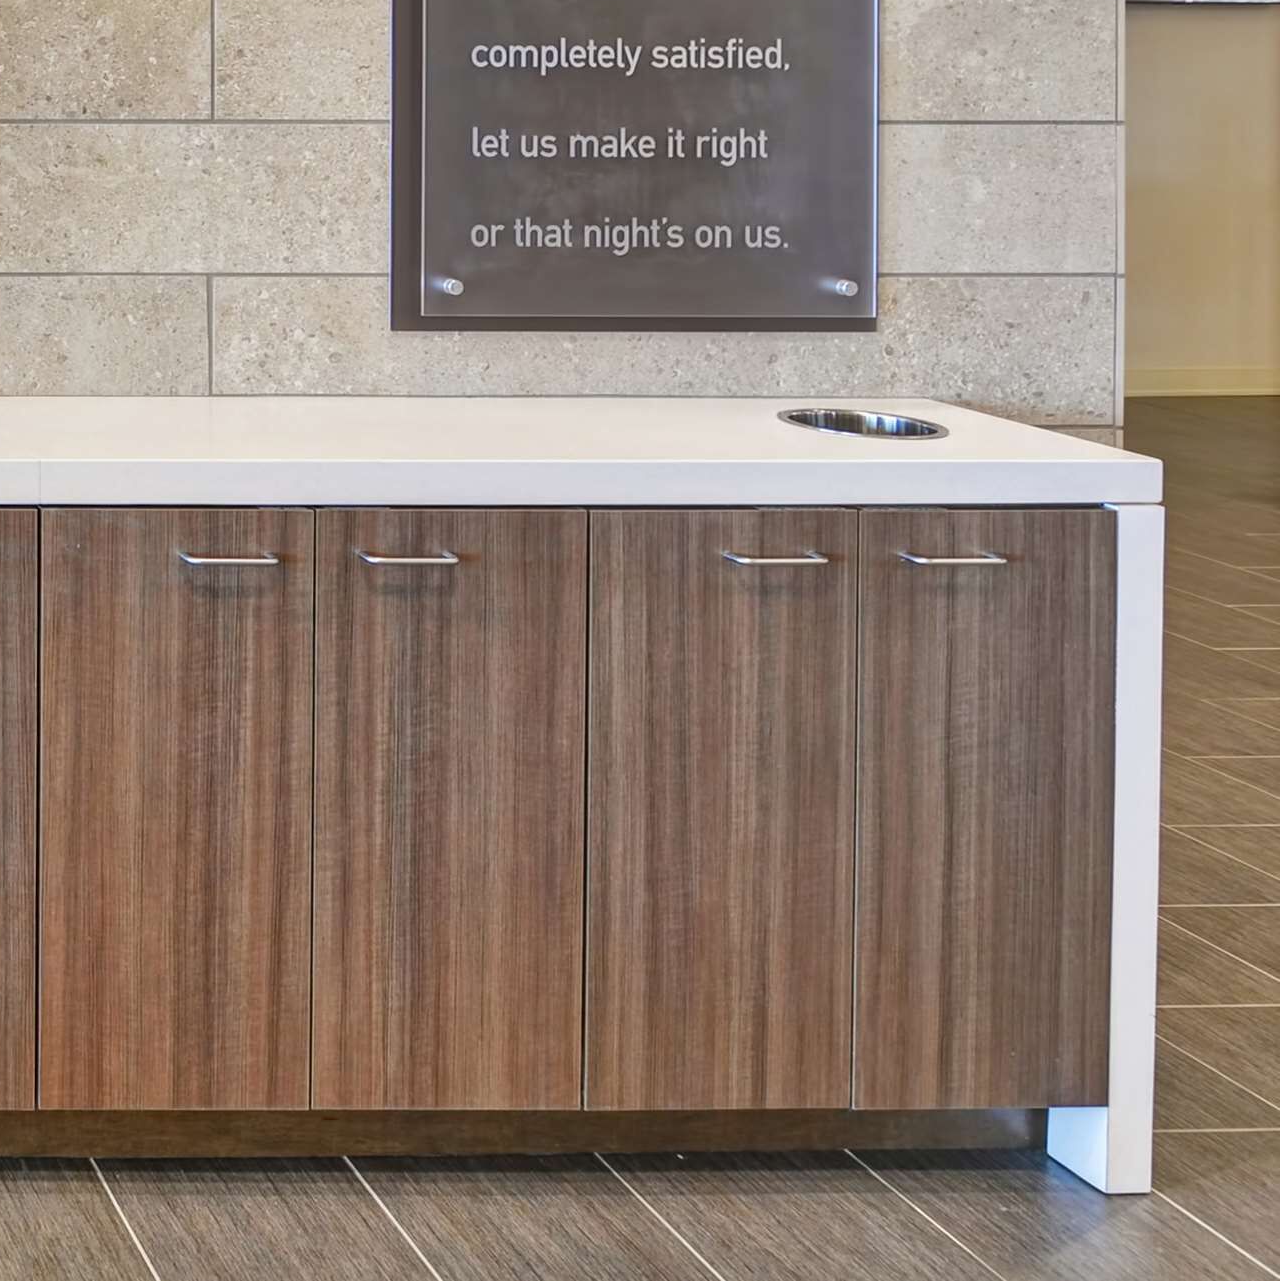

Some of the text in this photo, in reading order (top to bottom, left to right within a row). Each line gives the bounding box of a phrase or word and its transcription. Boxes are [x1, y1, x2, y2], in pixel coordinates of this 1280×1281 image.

[471, 37, 790, 76] completely satisfied,
[472, 126, 768, 167] let us make it right
[471, 217, 789, 256] or that night's on us.
